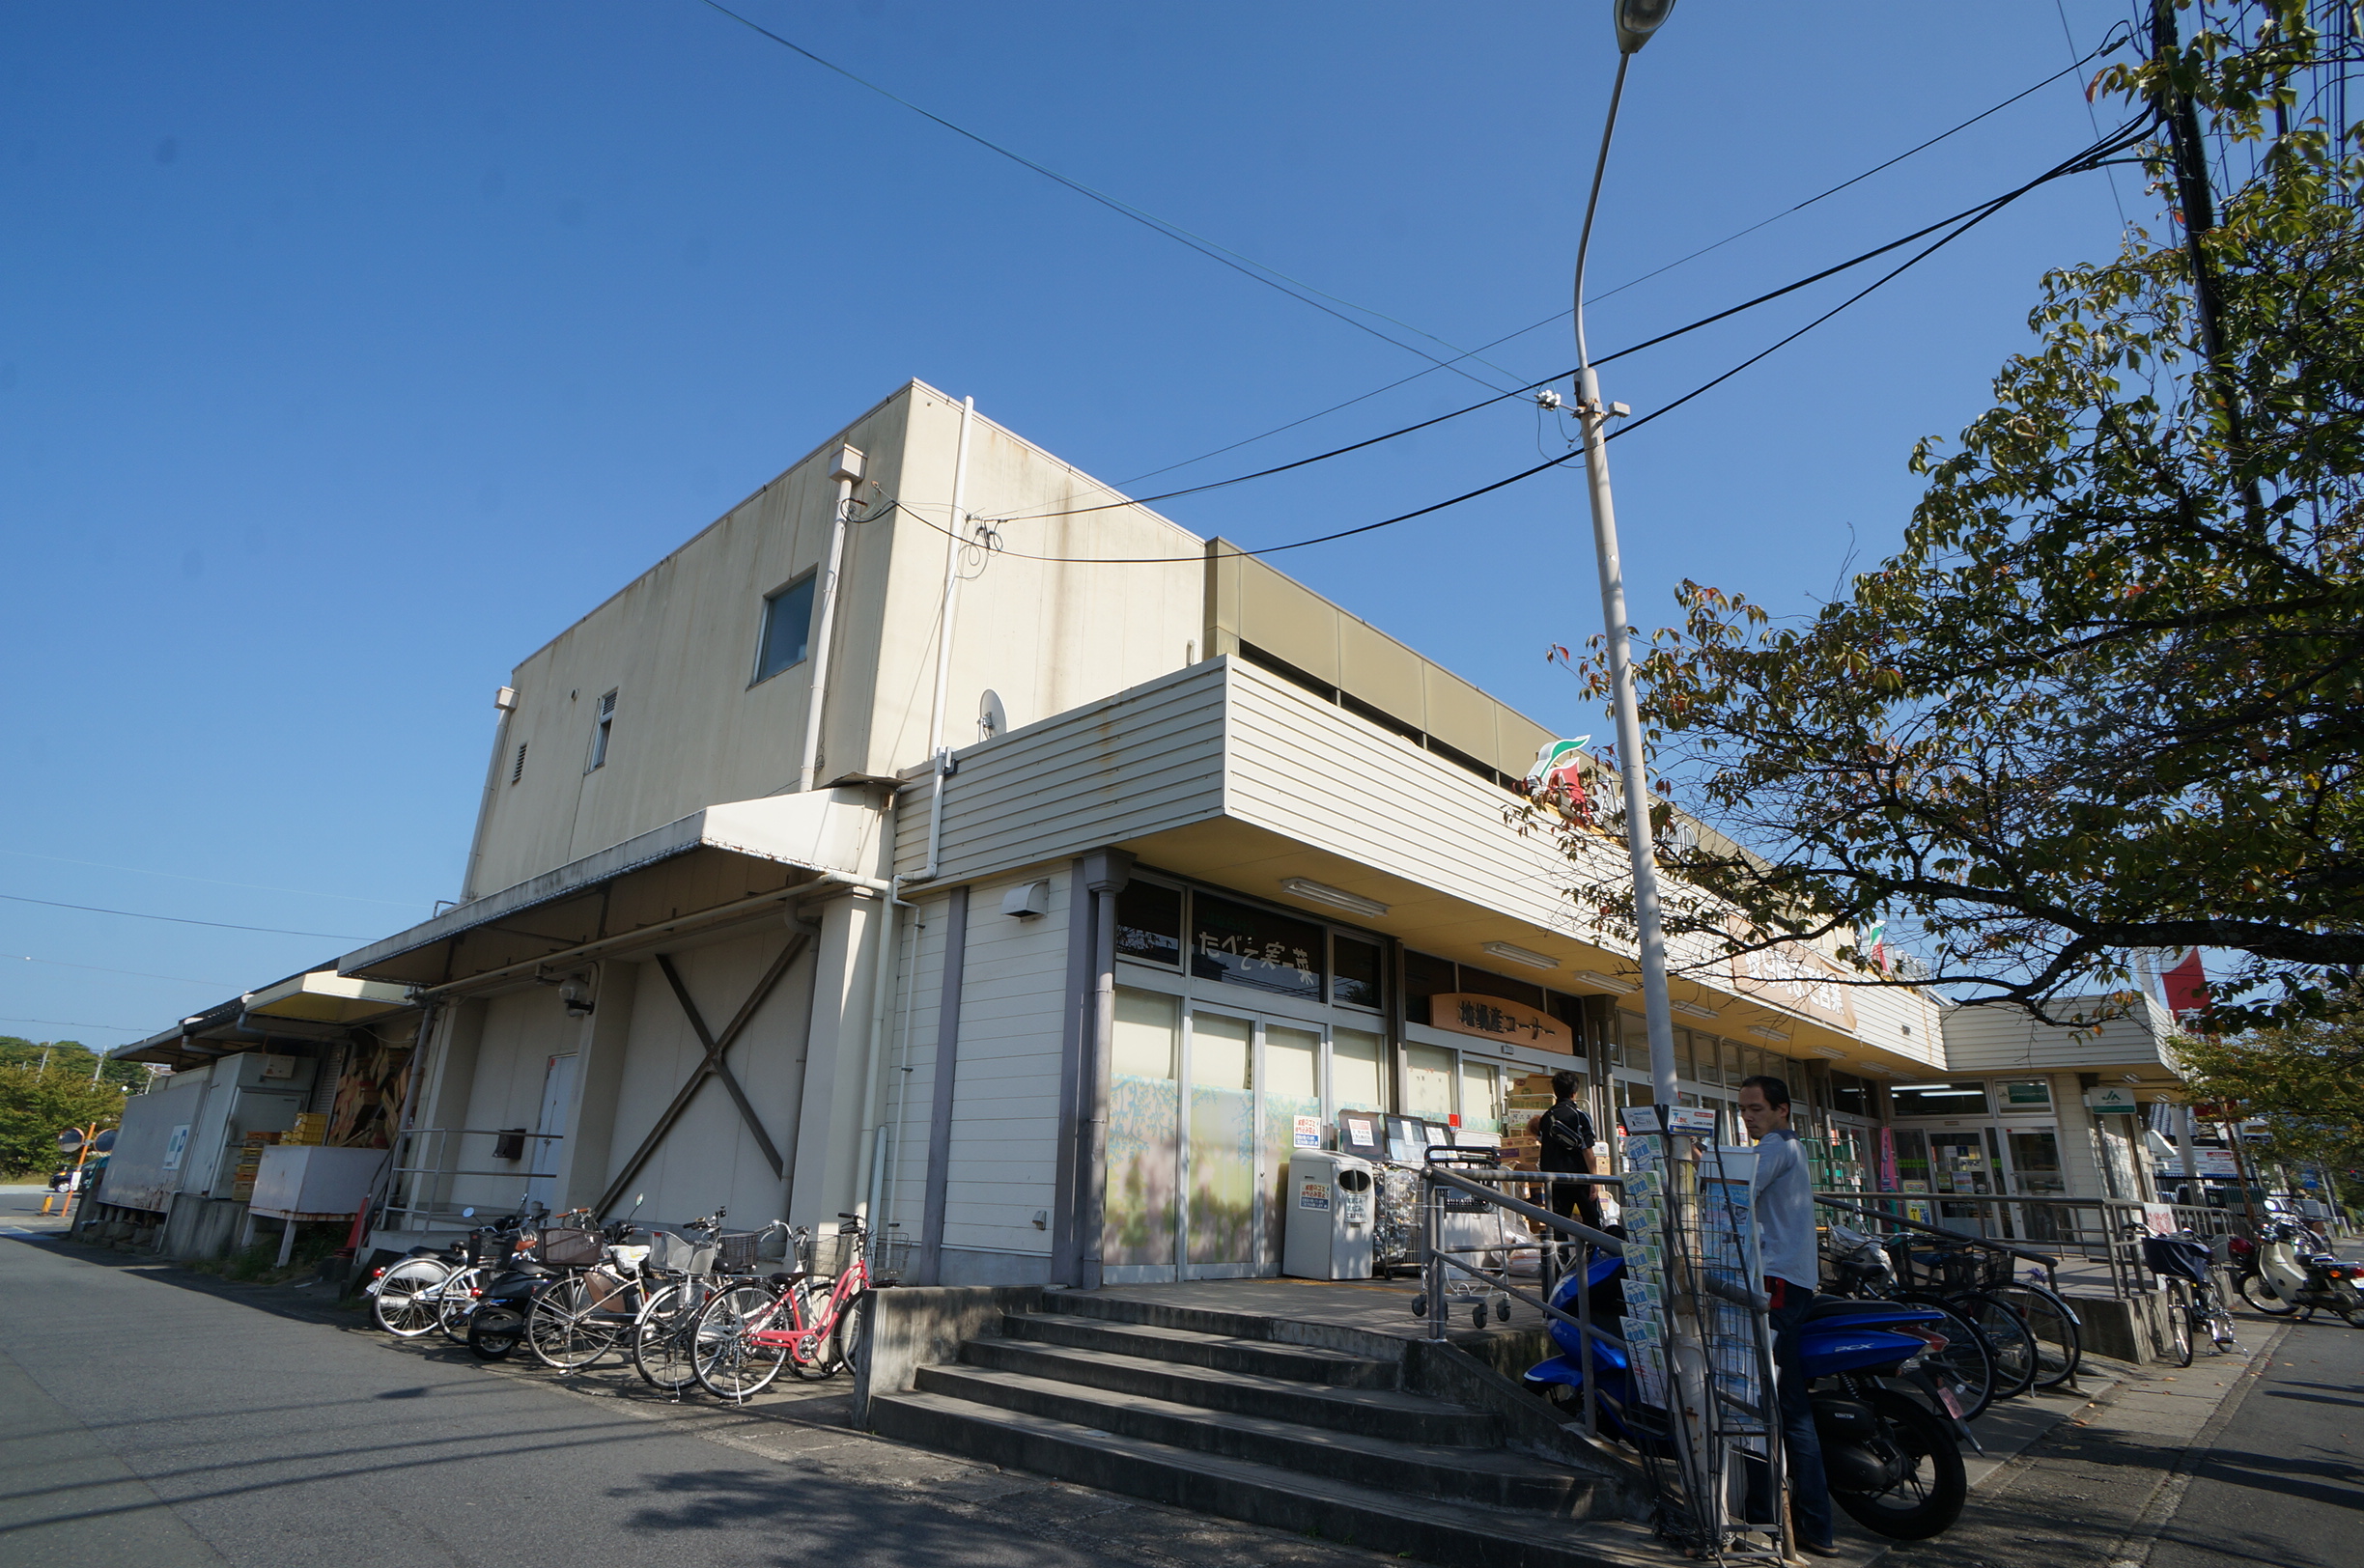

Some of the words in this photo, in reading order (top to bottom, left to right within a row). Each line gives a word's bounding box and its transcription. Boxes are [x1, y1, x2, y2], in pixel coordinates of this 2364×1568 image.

[1457, 1000, 1556, 1042] 地場産コーナー
[2101, 1090, 2122, 1101] JA
[1835, 1342, 1875, 1352] PCX
